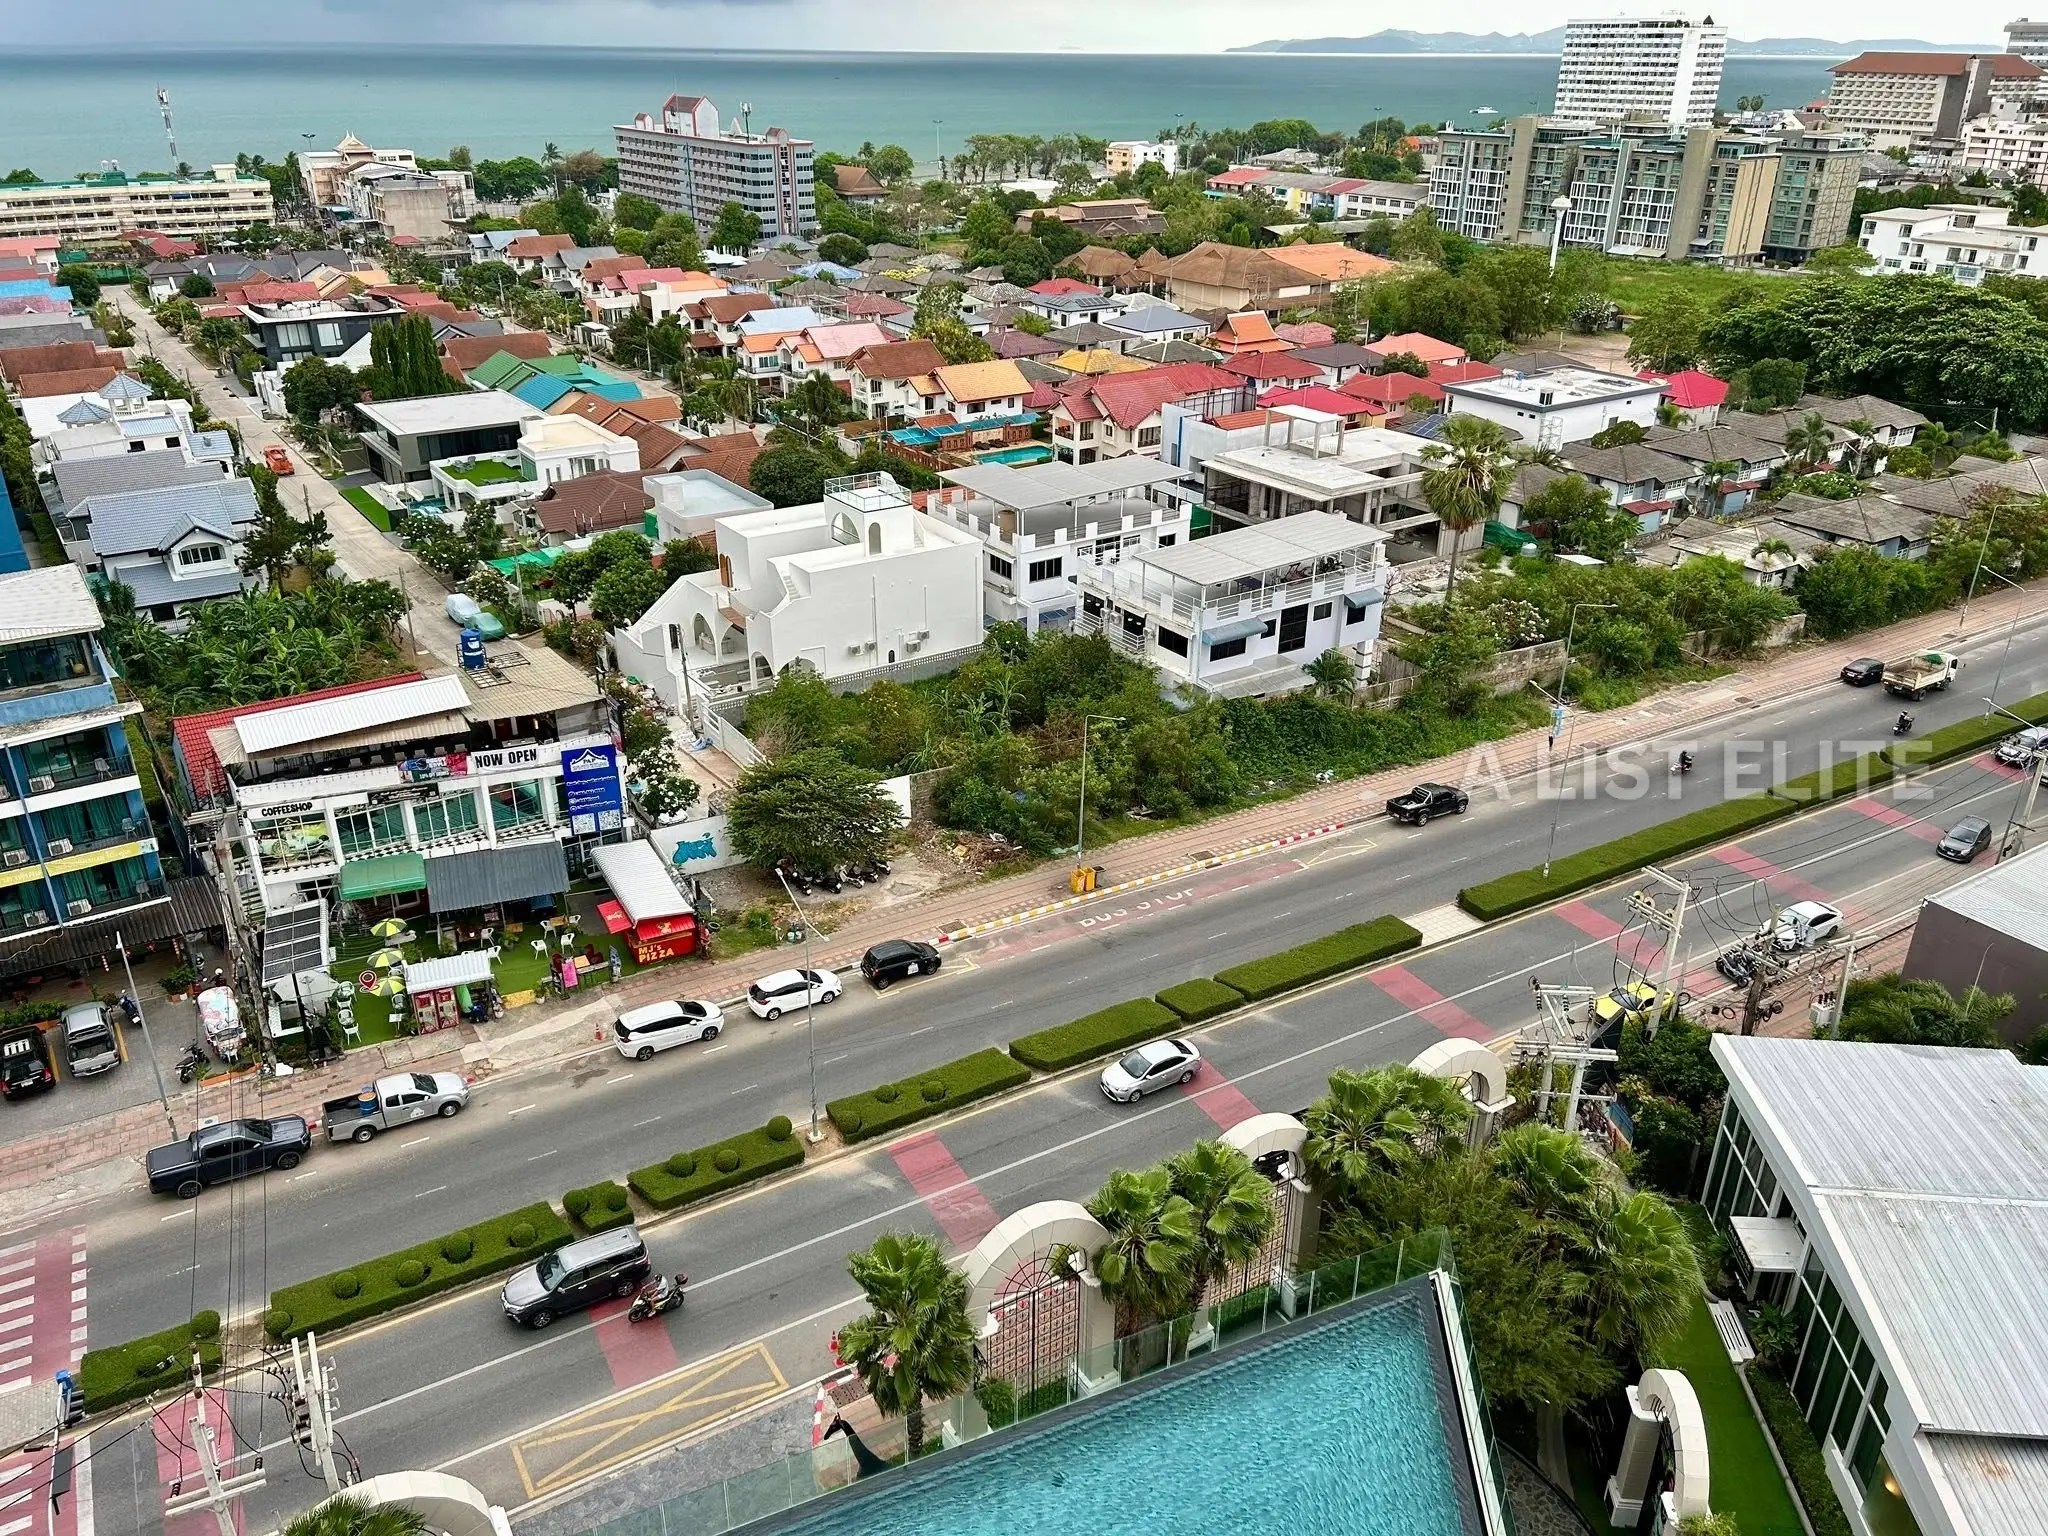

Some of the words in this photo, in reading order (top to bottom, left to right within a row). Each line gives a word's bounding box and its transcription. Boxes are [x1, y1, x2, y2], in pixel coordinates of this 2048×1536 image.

[475, 752, 503, 769] NOW
[508, 748, 537, 764] OPEN
[261, 801, 313, 817] COFFEESHOP
[638, 944, 662, 955] MJ's
[638, 948, 675, 963] PIZZA
